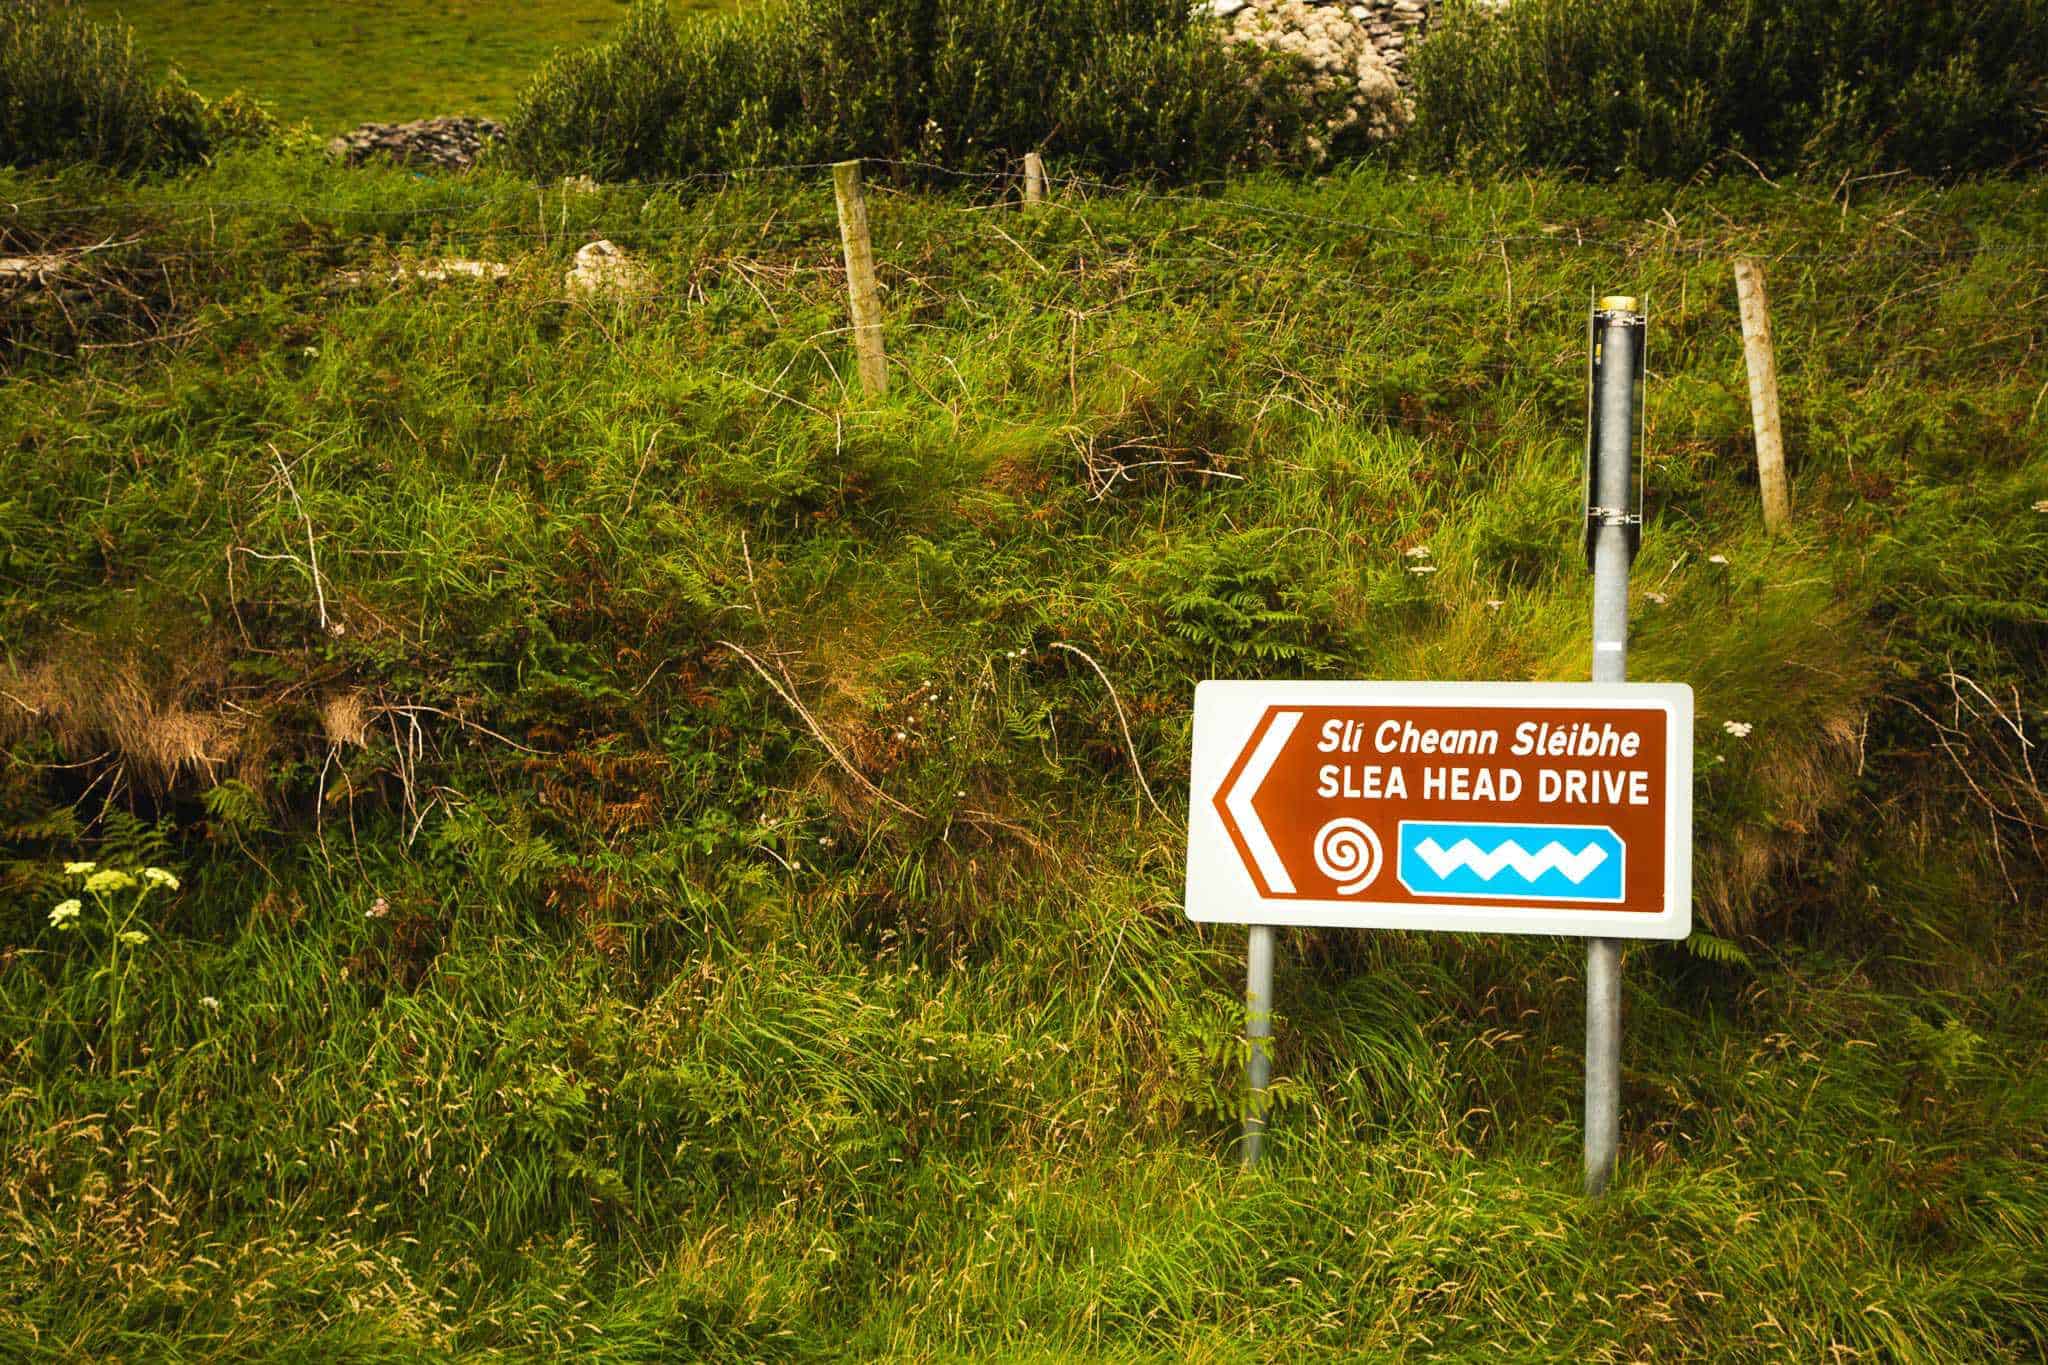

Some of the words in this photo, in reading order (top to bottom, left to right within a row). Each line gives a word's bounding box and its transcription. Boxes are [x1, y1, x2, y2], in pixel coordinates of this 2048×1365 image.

[1318, 720, 1364, 752] Slí
[1375, 720, 1498, 754] Cheann
[1511, 722, 1640, 757] Sléibhe
[1318, 765, 1407, 799] SLEA
[1424, 767, 1522, 801] HEAD
[1539, 769, 1648, 804] DRIVE
